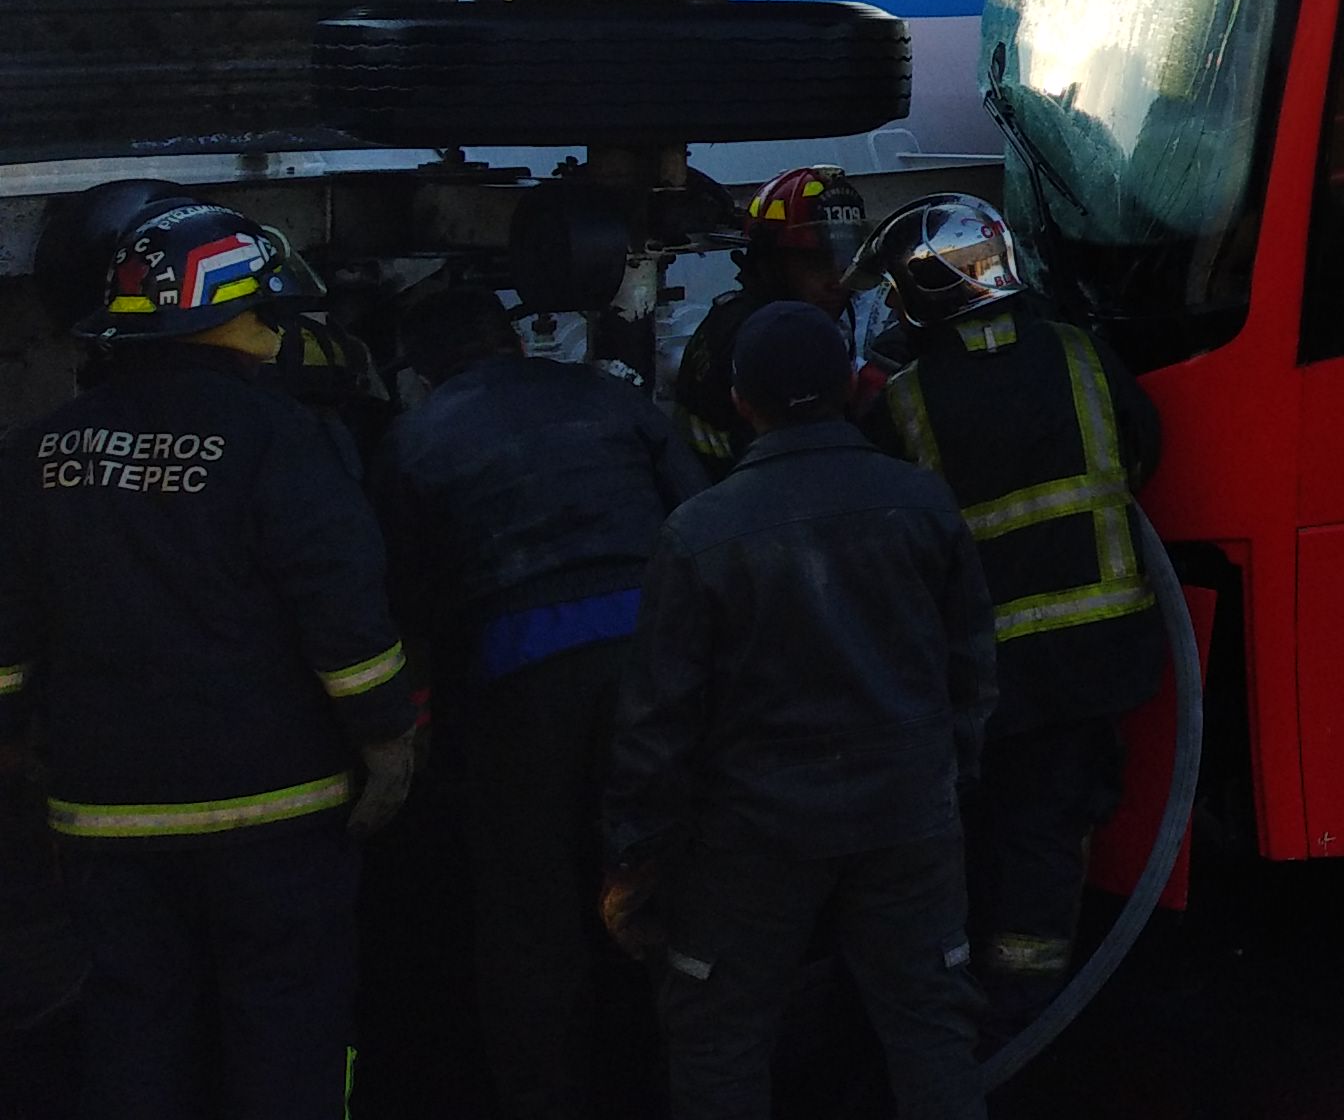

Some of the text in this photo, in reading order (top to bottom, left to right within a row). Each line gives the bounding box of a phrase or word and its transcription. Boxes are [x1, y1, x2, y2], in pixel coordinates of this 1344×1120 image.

[103, 235, 179, 307] SCATE
[37, 427, 226, 461] BOMBEROS
[42, 459, 209, 493] ECATEPEC
